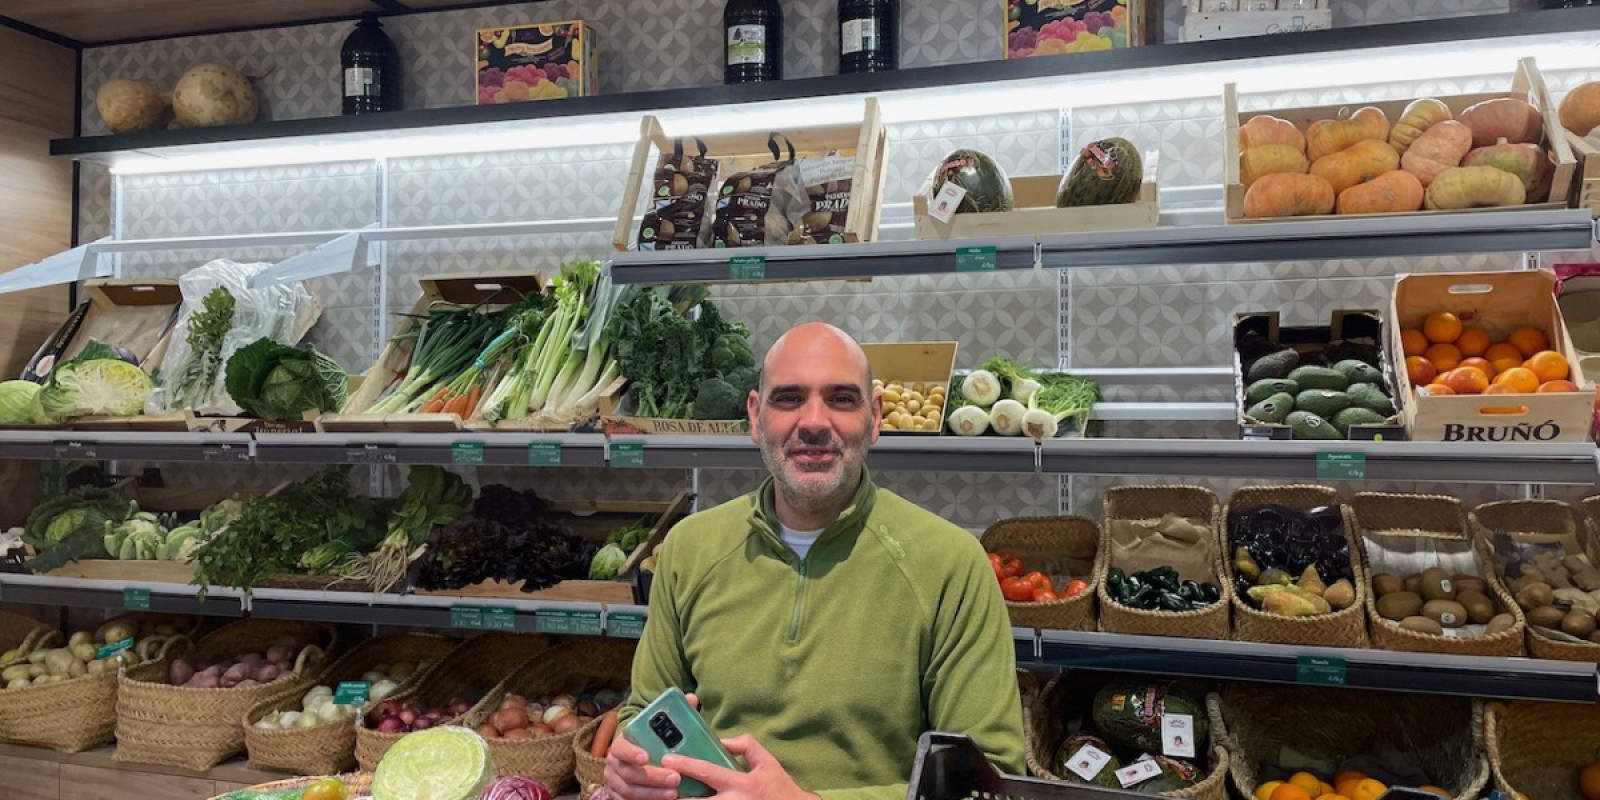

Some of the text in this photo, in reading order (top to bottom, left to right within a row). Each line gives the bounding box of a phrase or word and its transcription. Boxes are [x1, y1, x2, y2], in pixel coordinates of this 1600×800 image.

[737, 197, 767, 208] PRADO
[815, 198, 849, 212] PRAD
[653, 420, 685, 432] ROSA
[687, 422, 705, 433] DE
[1441, 419, 1561, 442] BRUÑÓ
